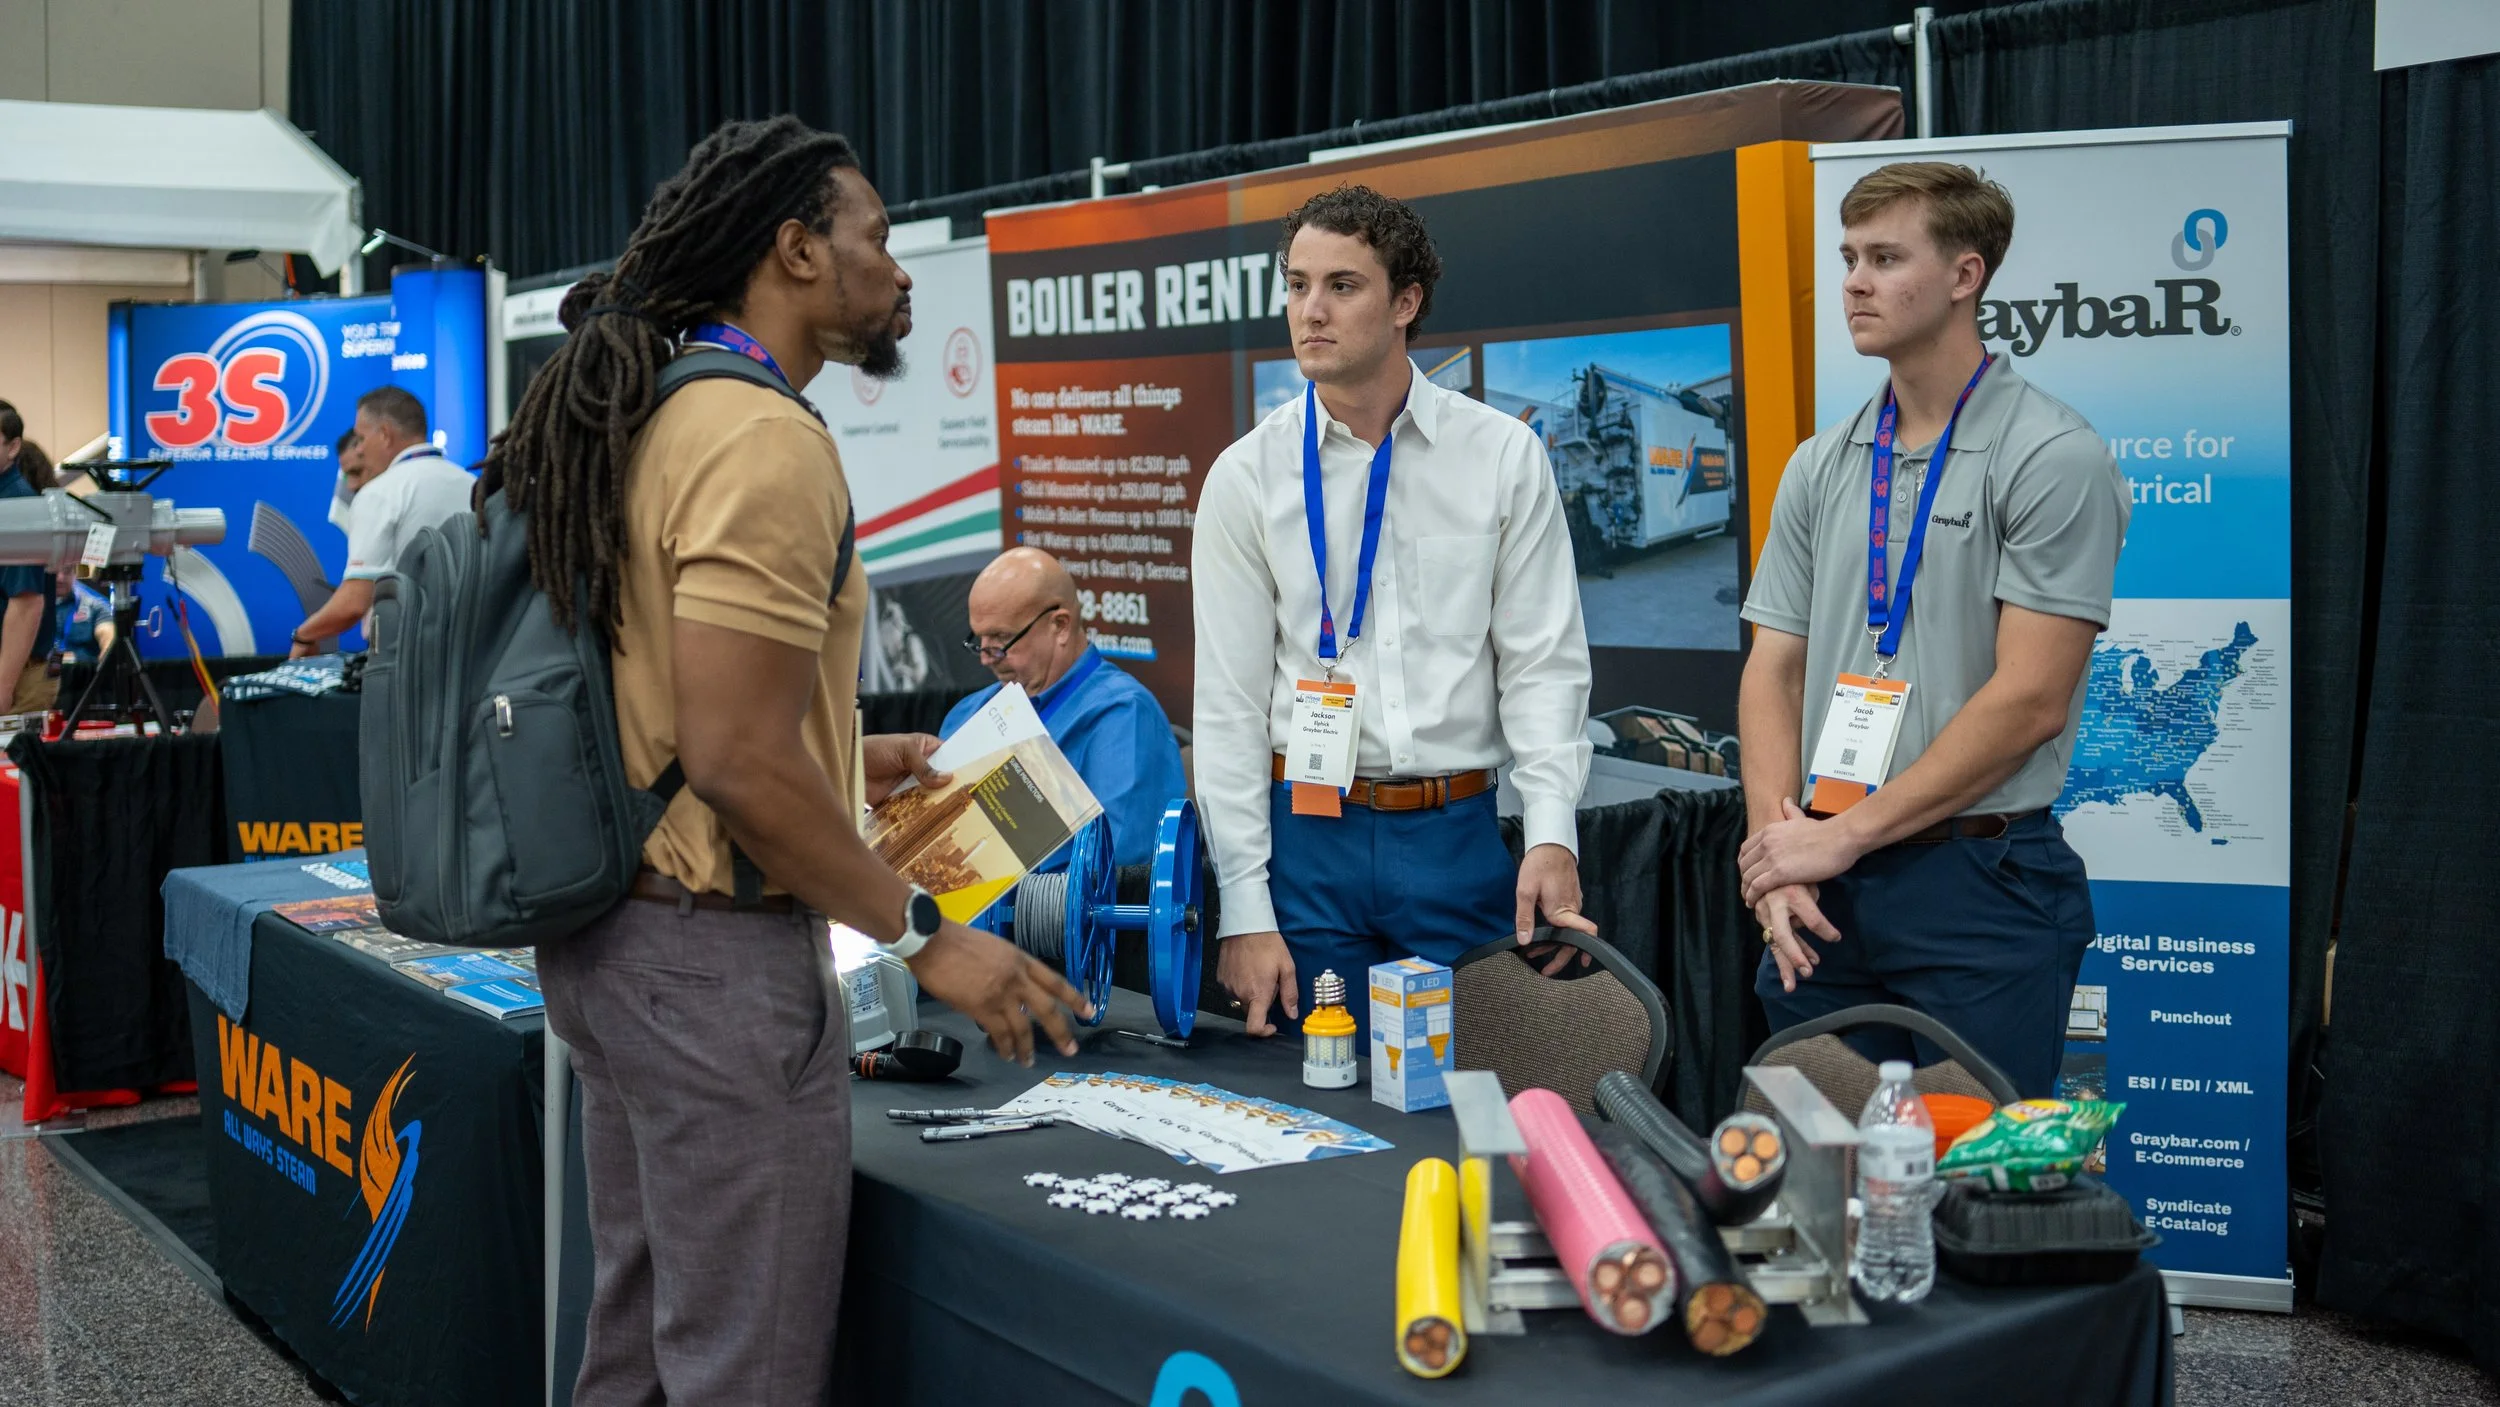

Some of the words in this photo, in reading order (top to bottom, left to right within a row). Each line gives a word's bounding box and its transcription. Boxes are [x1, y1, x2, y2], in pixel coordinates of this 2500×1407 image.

[1006, 269, 1146, 337] BOILER
[1155, 252, 1288, 328] RENTA
[1976, 278, 2232, 357] aybaR
[145, 347, 289, 448] 3S
[1010, 387, 1030, 409] No
[1031, 392, 1056, 408] one
[1057, 386, 1112, 408] delivers
[1112, 384, 1132, 407] all
[1133, 383, 1182, 411] things
[1012, 416, 1051, 436] steam
[1052, 413, 1079, 436] like
[148, 446, 212, 462] SUPERIOR
[215, 446, 269, 462] SEALING
[272, 445, 328, 460] SERVICES
[2110, 435, 2172, 459] rce
[2183, 429, 2235, 459] for
[2128, 473, 2212, 504] trical
[1099, 558, 1126, 577] Start
[1127, 560, 1144, 583] Up
[1145, 561, 1189, 582] Service
[1087, 627, 1153, 655] lers.com
[1310, 711, 1335, 720] Jackson
[1854, 707, 1874, 715] Jacob
[1848, 722, 1869, 730] Graybar
[237, 821, 364, 854] WARE
[2157, 936, 2256, 955] Business
[2121, 955, 2214, 974] Services
[1422, 977, 1440, 988] LED
[2150, 1010, 2232, 1026] Punchout
[217, 1013, 352, 1178] WARE
[2128, 1076, 2156, 1090] ESI
[2171, 1078, 2200, 1092] EDI
[2215, 1080, 2254, 1095] XML
[224, 1108, 241, 1145] ALL
[243, 1120, 273, 1166] WAYS
[276, 1144, 316, 1196] STEAM
[2130, 1132, 2240, 1151] Graybar.com
[2135, 1151, 2244, 1169] E-Commerce
[2146, 1198, 2232, 1215] Syndicate
[2145, 1215, 2228, 1236] E-Catalog
